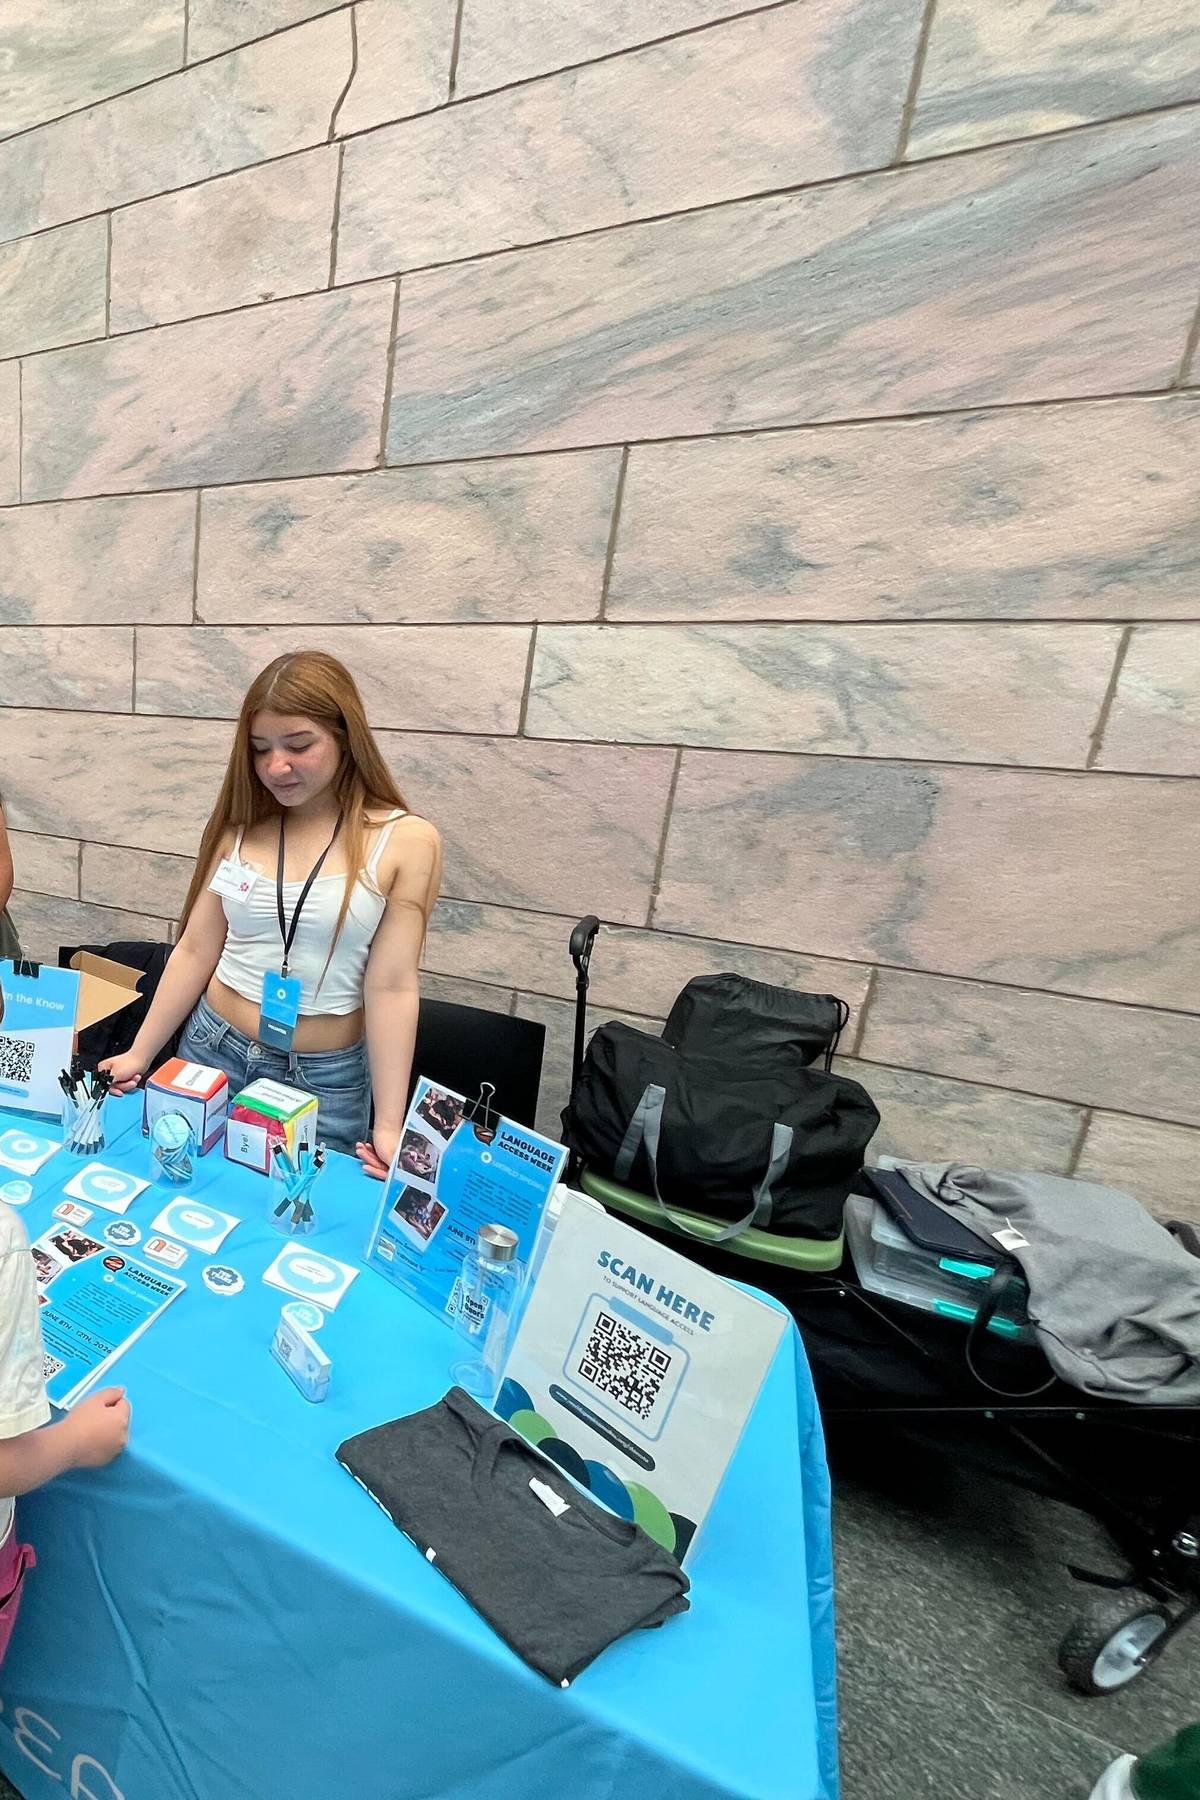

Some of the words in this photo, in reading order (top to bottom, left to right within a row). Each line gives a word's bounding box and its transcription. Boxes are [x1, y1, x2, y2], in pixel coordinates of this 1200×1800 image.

[16, 992, 32, 1005] the
[35, 997, 65, 1011] Know
[240, 1132, 248, 1154] Bye!
[500, 1131, 556, 1164] LANGUAGE
[498, 1141, 530, 1160] ACCESS
[530, 1157, 552, 1173] WEEK
[447, 1224, 464, 1240] JUNE
[124, 1272, 150, 1288] ACCESS
[150, 1285, 170, 1296] WEEK
[127, 1266, 174, 1292] LANGUAGE
[597, 1250, 654, 1295] SCAN
[656, 1284, 716, 1332] HERE
[42, 1310, 60, 1323] JUNE
[603, 1276, 612, 1284] TO
[612, 1282, 638, 1299] SUPPORT
[638, 1298, 670, 1320] LANGUAGE
[670, 1319, 694, 1336] ACCESS
